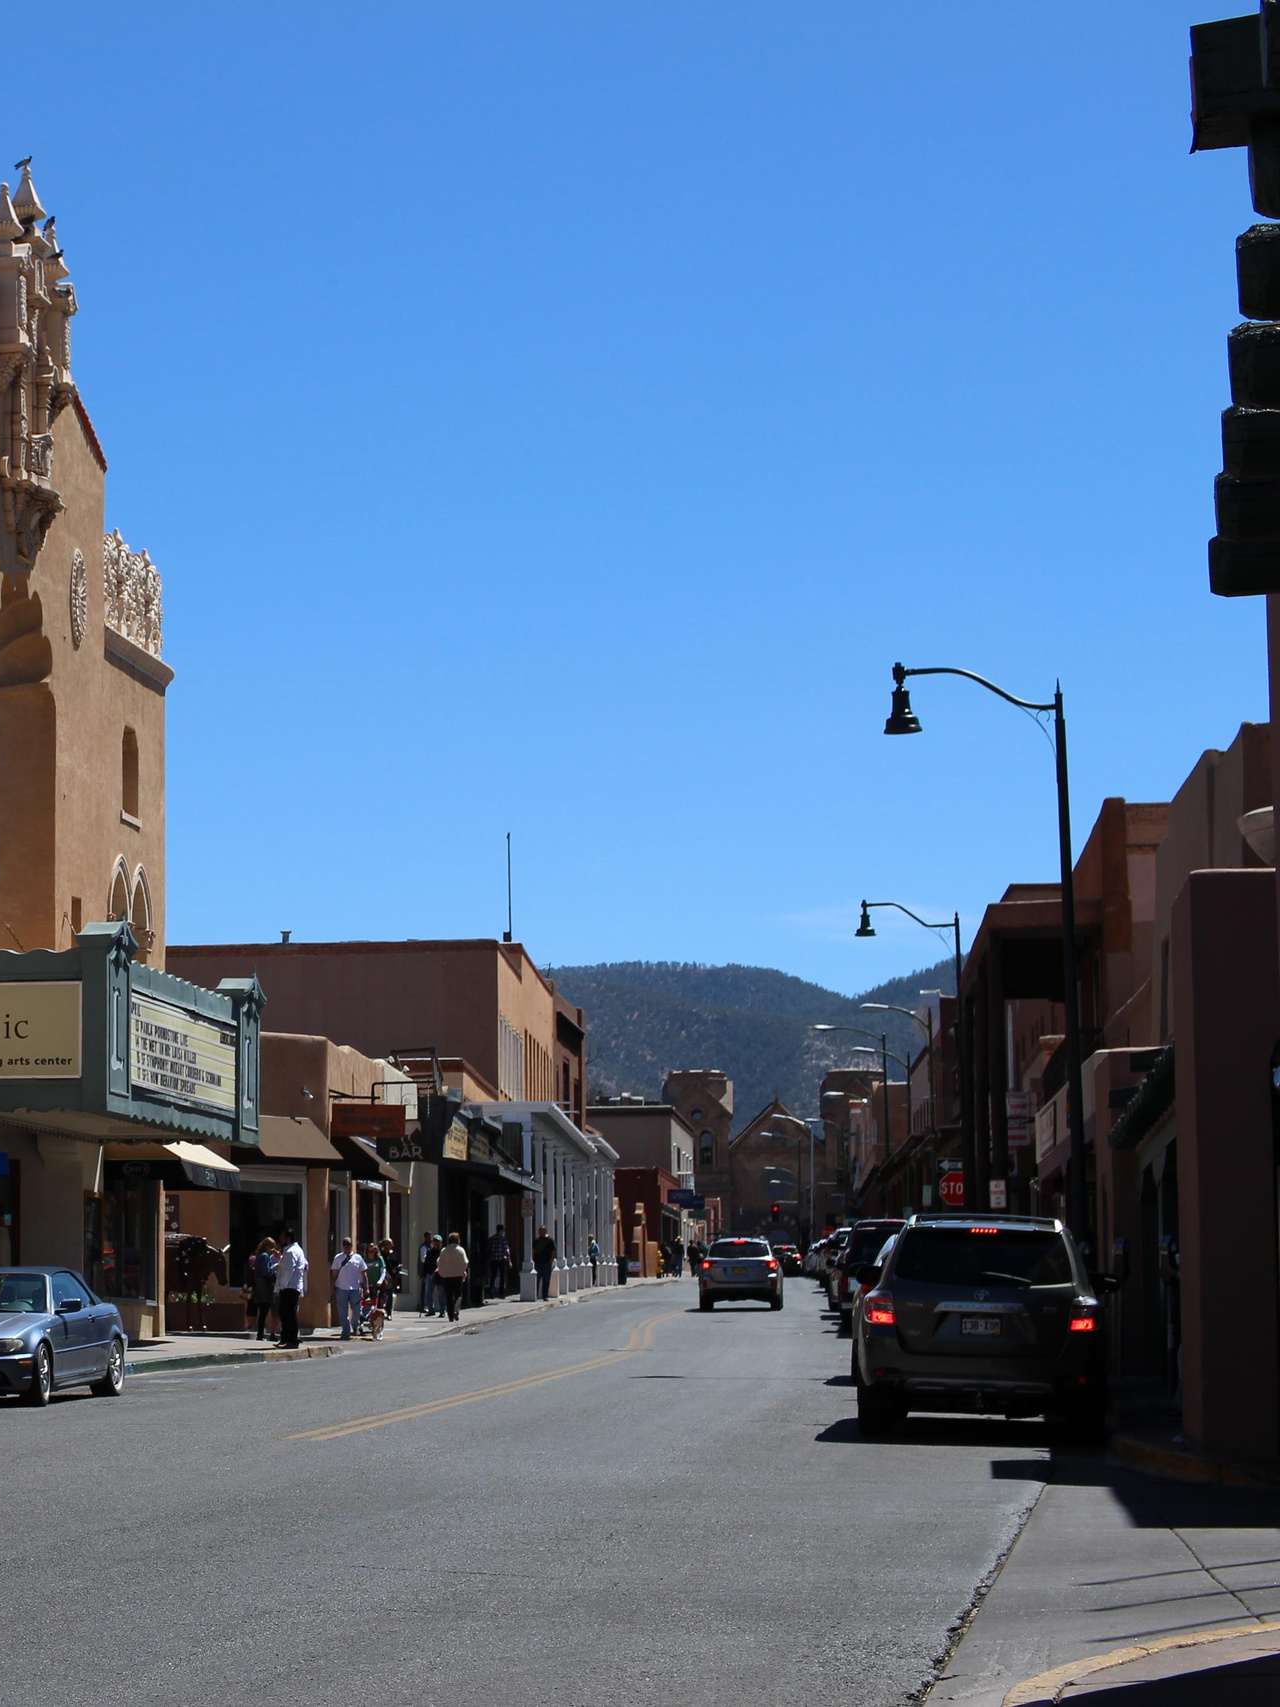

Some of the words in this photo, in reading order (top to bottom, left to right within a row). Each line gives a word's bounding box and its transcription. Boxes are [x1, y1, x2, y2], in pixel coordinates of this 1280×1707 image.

[140, 1020, 154, 1036] PAULA
[154, 1025, 179, 1045] POUNDSTONE
[180, 1033, 189, 1047] LIVE
[140, 1037, 148, 1051] THE
[148, 1040, 157, 1054] MET
[7, 1057, 30, 1066] arts
[34, 1057, 72, 1066] center
[169, 1060, 185, 1078] MOZART
[150, 1071, 158, 1085] HOW
[160, 1074, 179, 1091] BEHAVIOR
[179, 1080, 197, 1095] SPREADS
[389, 1146, 423, 1160] BAR
[940, 1182, 964, 1195] STO
